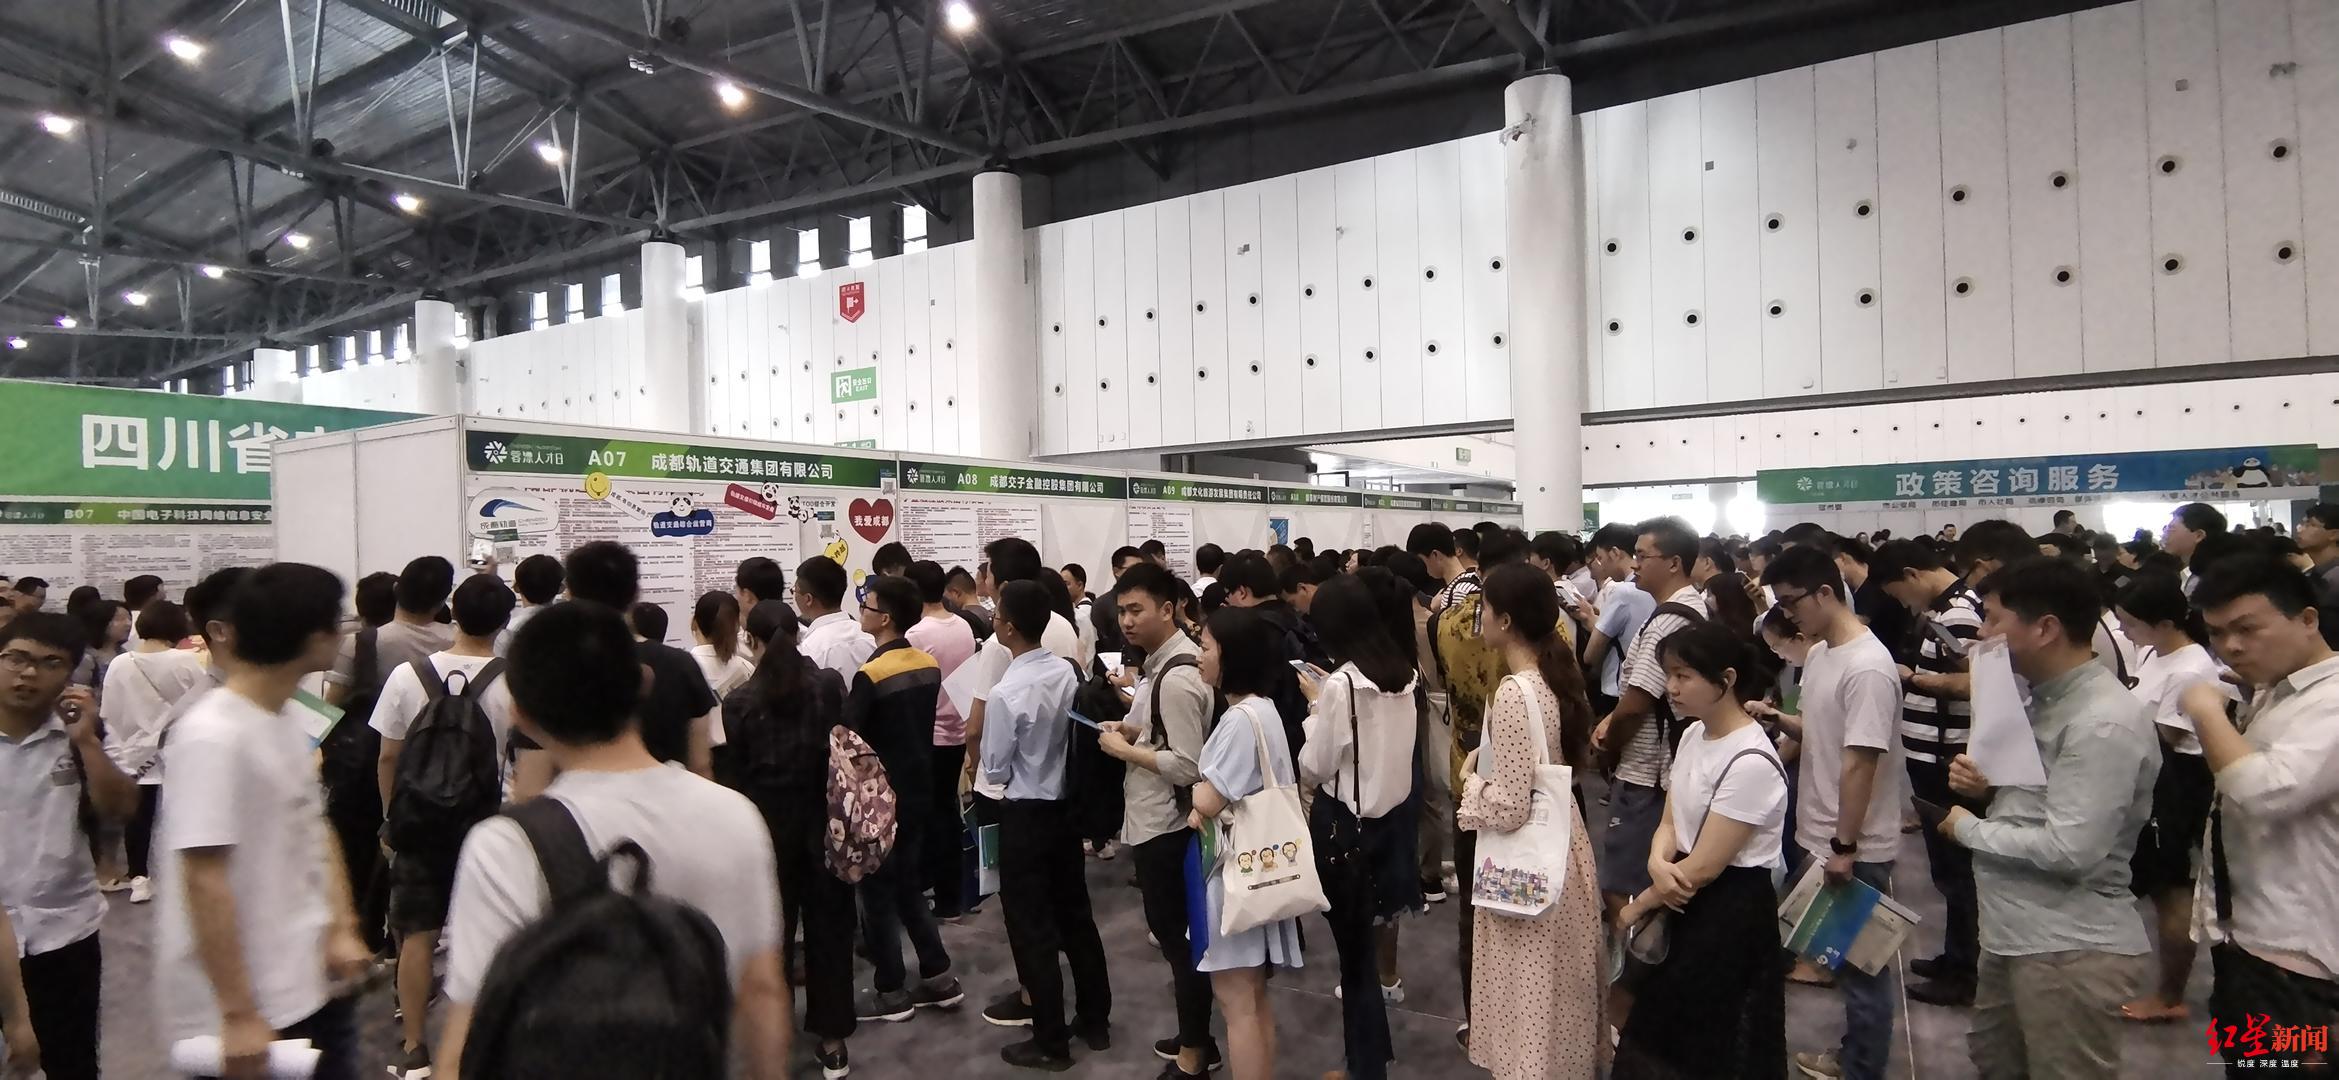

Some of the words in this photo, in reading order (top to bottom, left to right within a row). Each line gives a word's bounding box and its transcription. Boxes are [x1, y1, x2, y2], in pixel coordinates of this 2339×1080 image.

[588, 450, 626, 467] A07
[652, 453, 833, 479] 成都轨道交通集团有限公司
[957, 473, 978, 485] A08
[989, 475, 1104, 493] 成都交子金融控股集团有限公司
[1895, 463, 2120, 496] 政策咨询服务
[1162, 485, 1176, 495] A09
[64, 509, 94, 519] B07
[854, 515, 889, 527] 我爱成都
